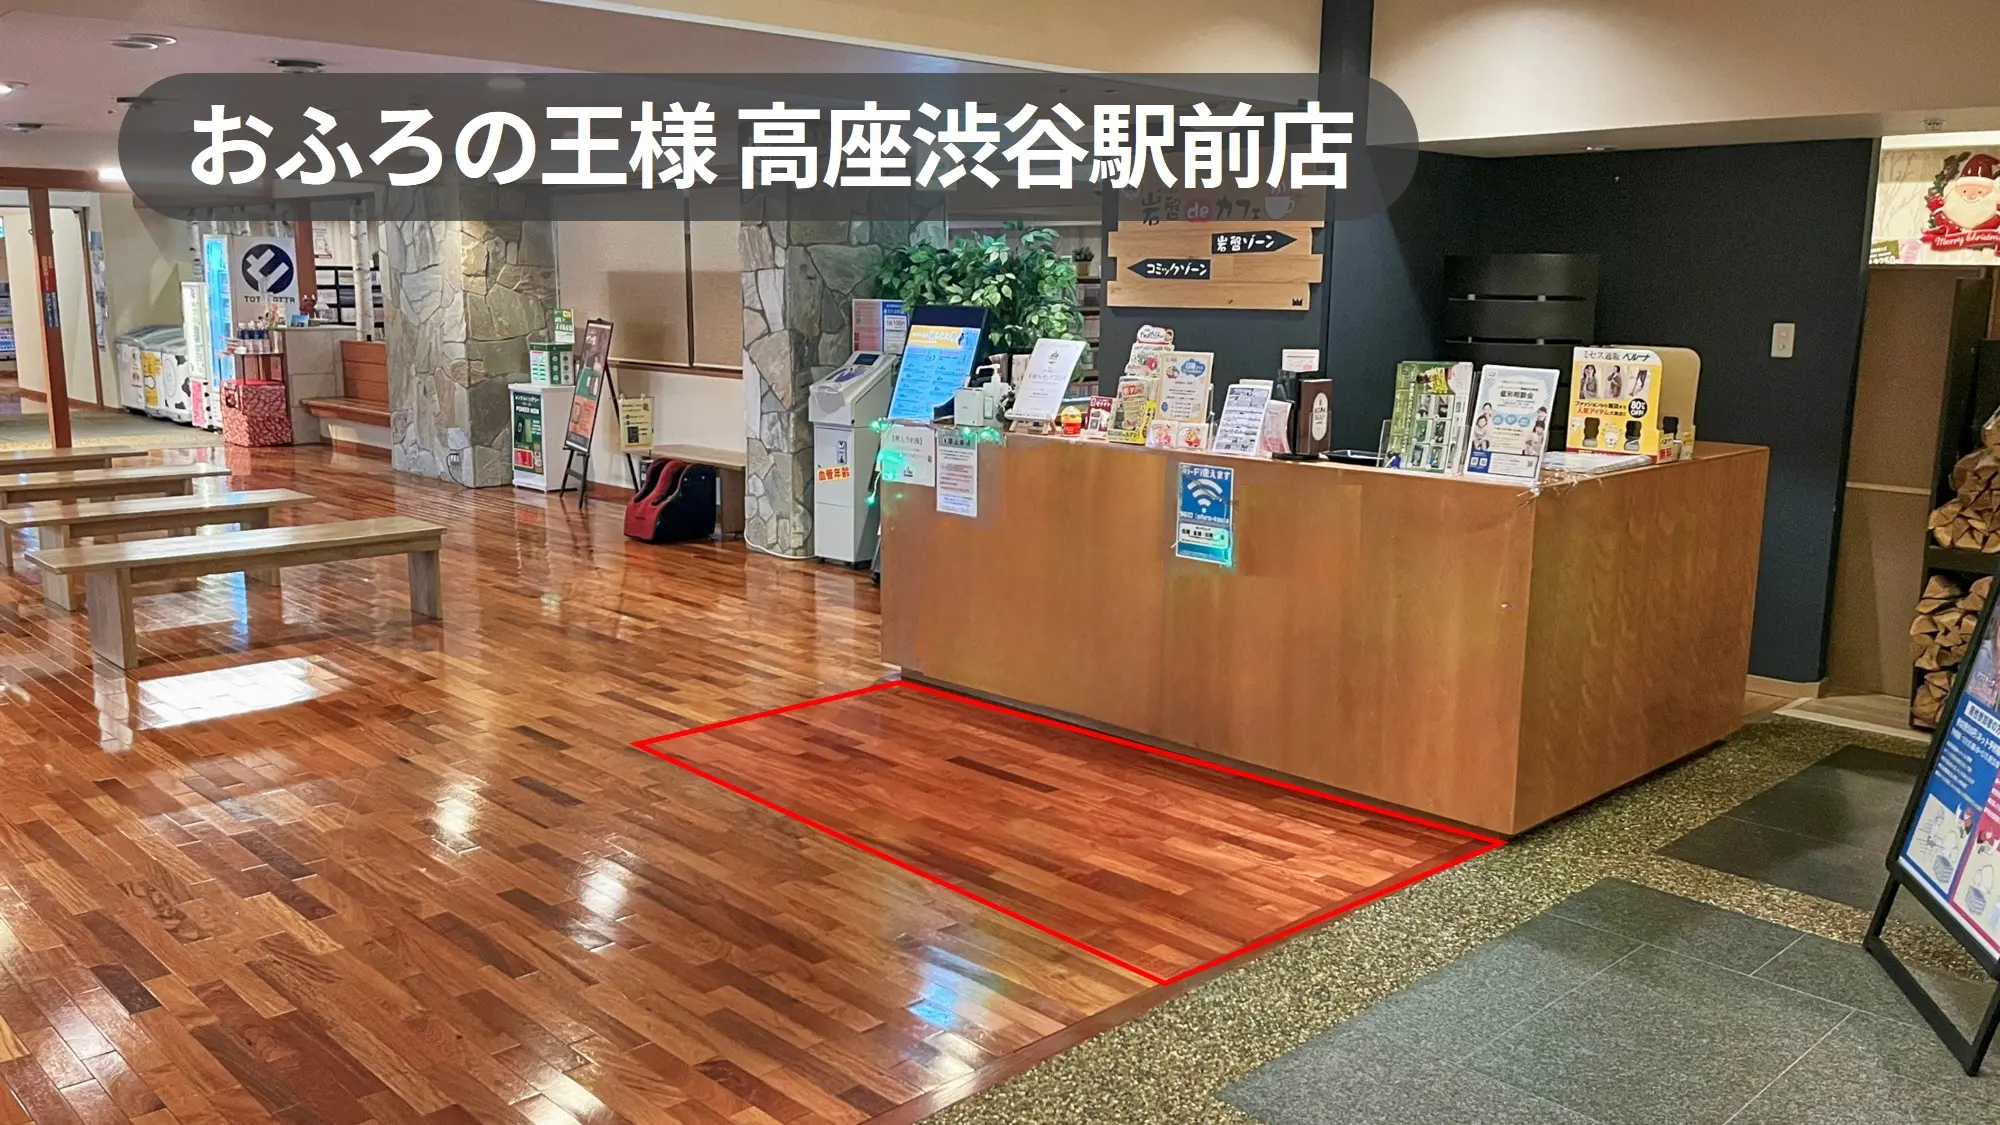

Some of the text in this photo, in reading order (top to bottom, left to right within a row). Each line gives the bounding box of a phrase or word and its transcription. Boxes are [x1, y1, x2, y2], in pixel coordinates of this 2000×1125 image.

[1187, 201, 1209, 219] de
[1216, 195, 1261, 220] カフェ
[1217, 235, 1275, 252] 岩盤ゾーン
[1935, 234, 1964, 247] Merry
[1146, 263, 1208, 275] コミックゾーン
[1622, 353, 1651, 362] ベルーナ
[817, 467, 850, 481] 血管年齢
